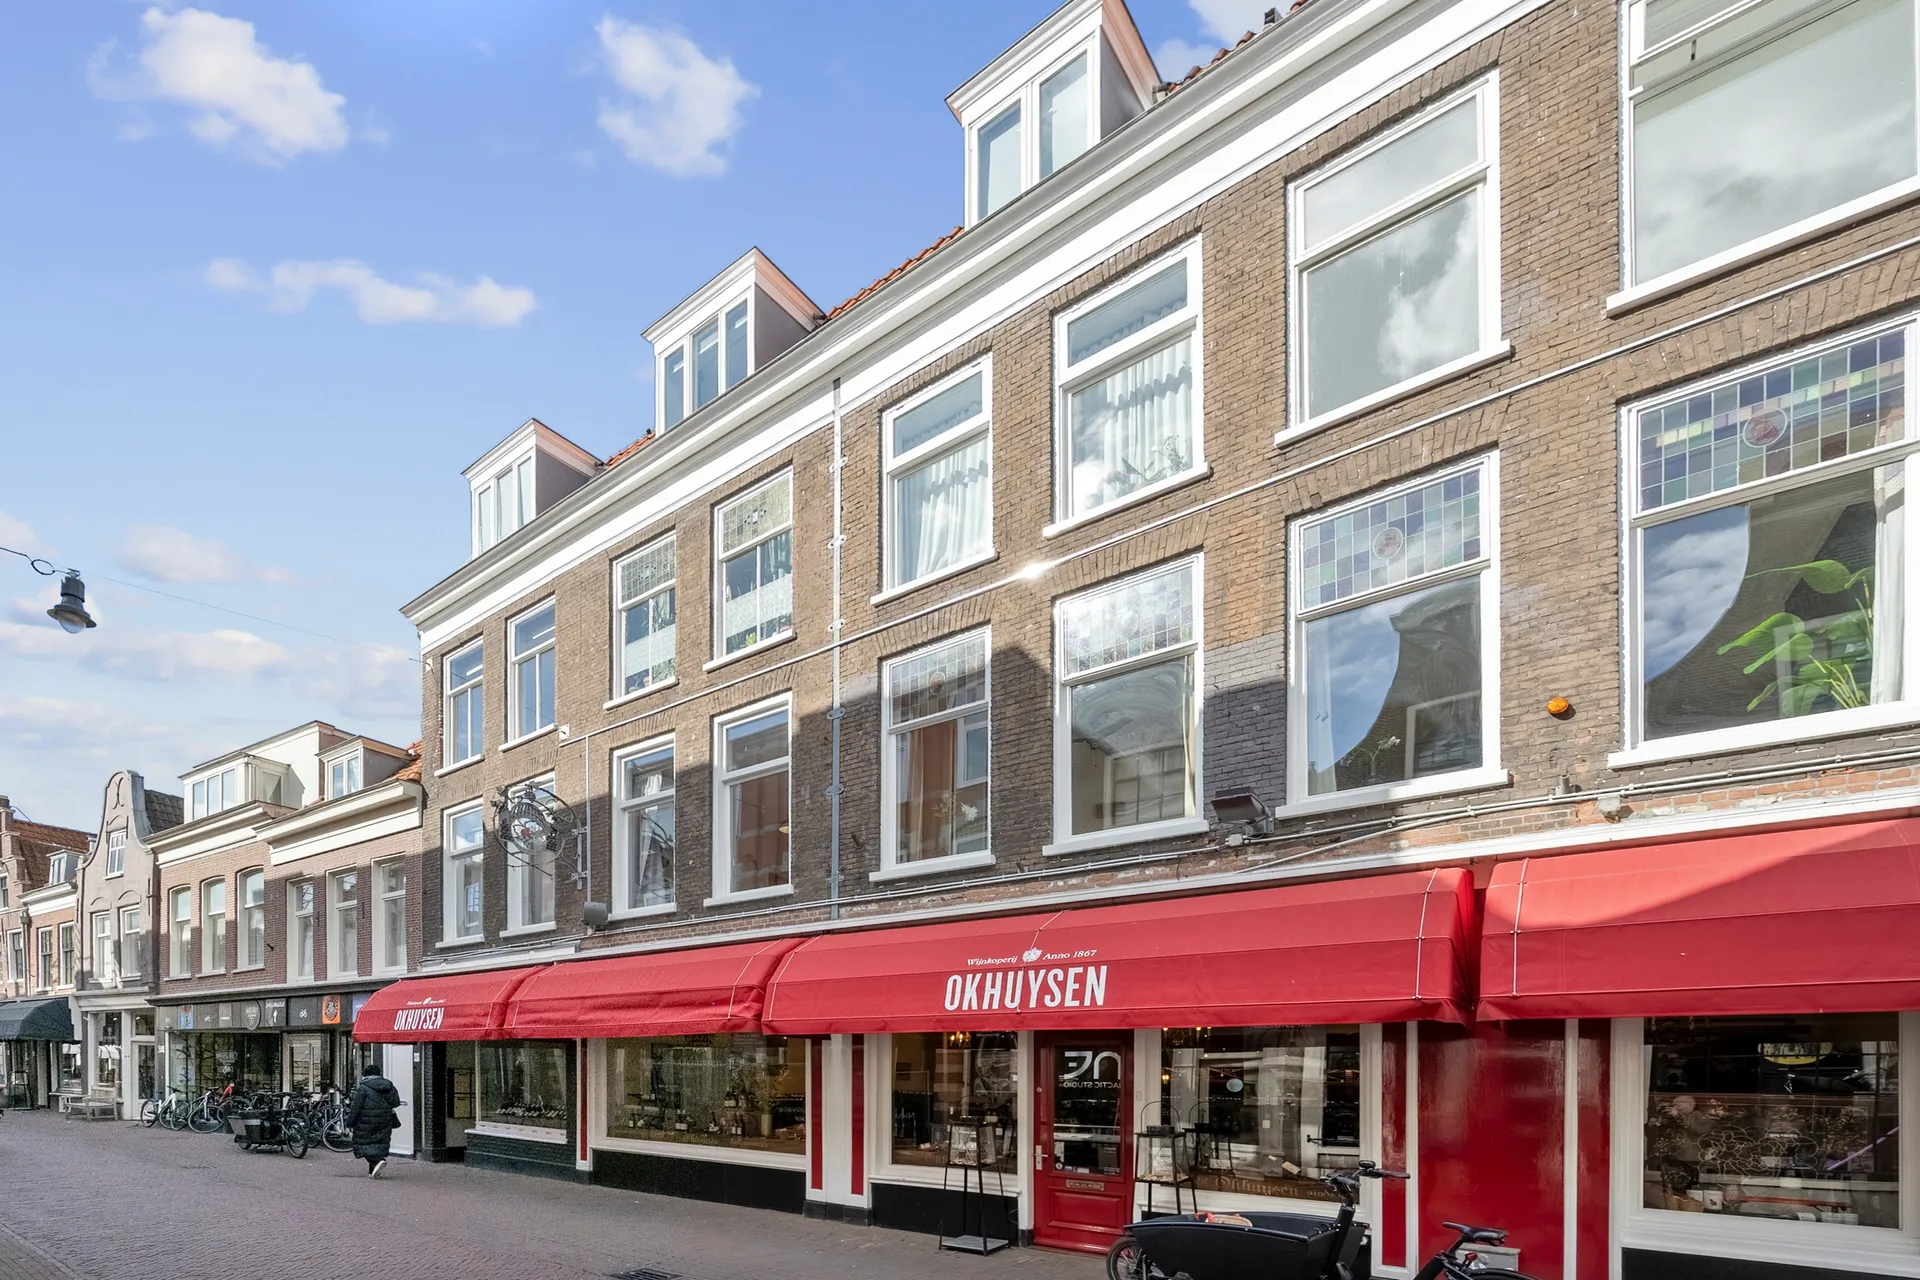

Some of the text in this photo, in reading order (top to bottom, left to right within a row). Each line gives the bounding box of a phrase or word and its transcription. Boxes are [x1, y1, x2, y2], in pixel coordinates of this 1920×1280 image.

[966, 949, 1098, 966] Wijnkoperij Anno 1867
[944, 965, 1108, 1011] OKHUYSEN
[393, 1007, 445, 1031] OKHUYSEN
